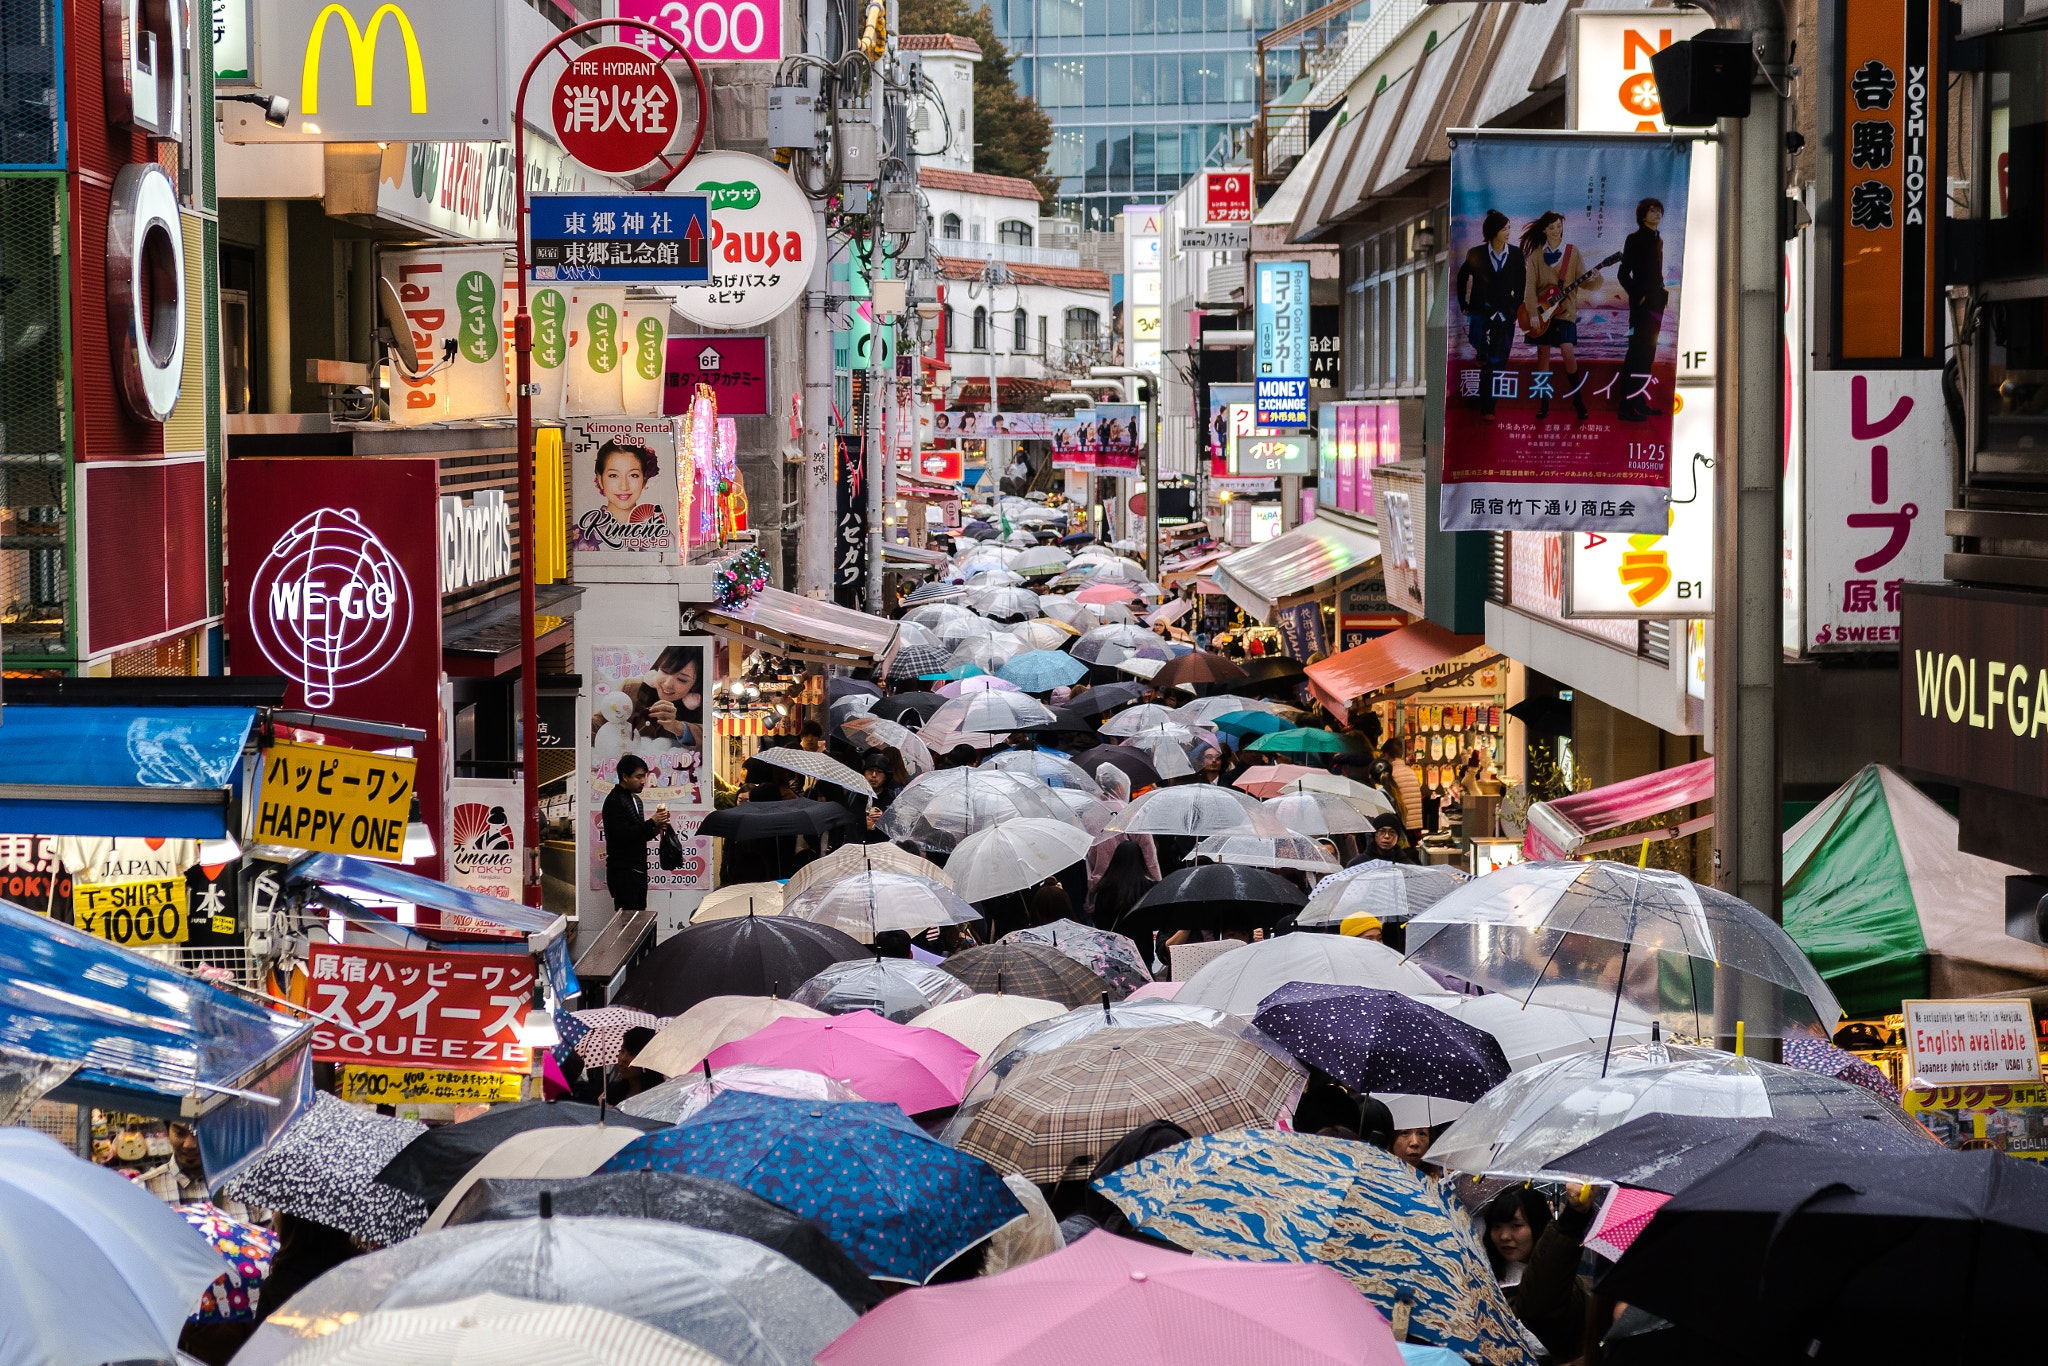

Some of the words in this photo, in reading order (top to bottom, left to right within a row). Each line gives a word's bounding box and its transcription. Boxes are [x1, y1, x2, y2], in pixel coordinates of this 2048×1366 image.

[573, 62, 598, 76] FIRE
[603, 62, 656, 76] HYDRANT
[563, 84, 669, 133] 消火栓
[563, 211, 673, 234] 東郷神社
[1217, 209, 1250, 220] アガサ
[1207, 232, 1248, 247] クリスティー
[563, 241, 679, 265] 東郷記念館
[708, 290, 745, 303] &ピザ
[1294, 270, 1303, 305] Rental
[467, 275, 488, 361] ラパウザ
[541, 292, 557, 367] ラパウザ
[1276, 271, 1290, 373] コインロッカー
[1294, 308, 1303, 333] Coin
[596, 306, 609, 372] ラパウザ
[644, 320, 656, 378] ラパウザ
[702, 356, 717, 367] 6F
[1294, 336, 1303, 375] Locker
[1682, 352, 1707, 369] 1F
[1258, 381, 1306, 397] MONEY
[1460, 369, 1659, 400] 覆面系ノイズ
[1258, 398, 1307, 411] EXCHANGE
[586, 423, 632, 432] Kimono
[636, 423, 672, 432] Rental
[613, 434, 645, 446] Shop
[574, 444, 591, 453] 3F
[1628, 461, 1664, 470] ROADSHOW
[1847, 375, 1919, 573] レープ
[1470, 498, 1636, 517] 原宿竹下通り商店会
[578, 509, 670, 550] Kimono
[440, 492, 511, 593] cDonald's
[622, 538, 668, 547] TOKYO
[838, 512, 862, 586] ハセガワ
[271, 581, 326, 621] WE
[339, 581, 393, 620] GO
[1351, 594, 1368, 602] Coin
[1677, 581, 1702, 598] B1
[267, 756, 409, 805] ハッピーワン
[646, 771, 690, 787] AGIC
[259, 801, 343, 845] HAPPY
[351, 815, 402, 853] ONE
[101, 860, 170, 877] JAPAN
[470, 866, 512, 874] TOKYO
[81, 881, 174, 909] T-SHIRT
[196, 883, 226, 918] 本
[81, 903, 180, 944] ¥1000
[313, 954, 533, 993] 原宿ハッピーワン
[313, 981, 532, 1048] スクイーズ
[1915, 1011, 1922, 1023] We
[1955, 1011, 1966, 1022] have
[1967, 1010, 1978, 1022] this
[1992, 1011, 1999, 1022] in
[311, 1031, 529, 1062] SQUEEZE
[1917, 1029, 1966, 1055] English
[1969, 1029, 2026, 1052] available
[1917, 1061, 1948, 1074] Japanese
[1950, 1060, 1970, 1073] photo
[1973, 1060, 1999, 1072] sticker
